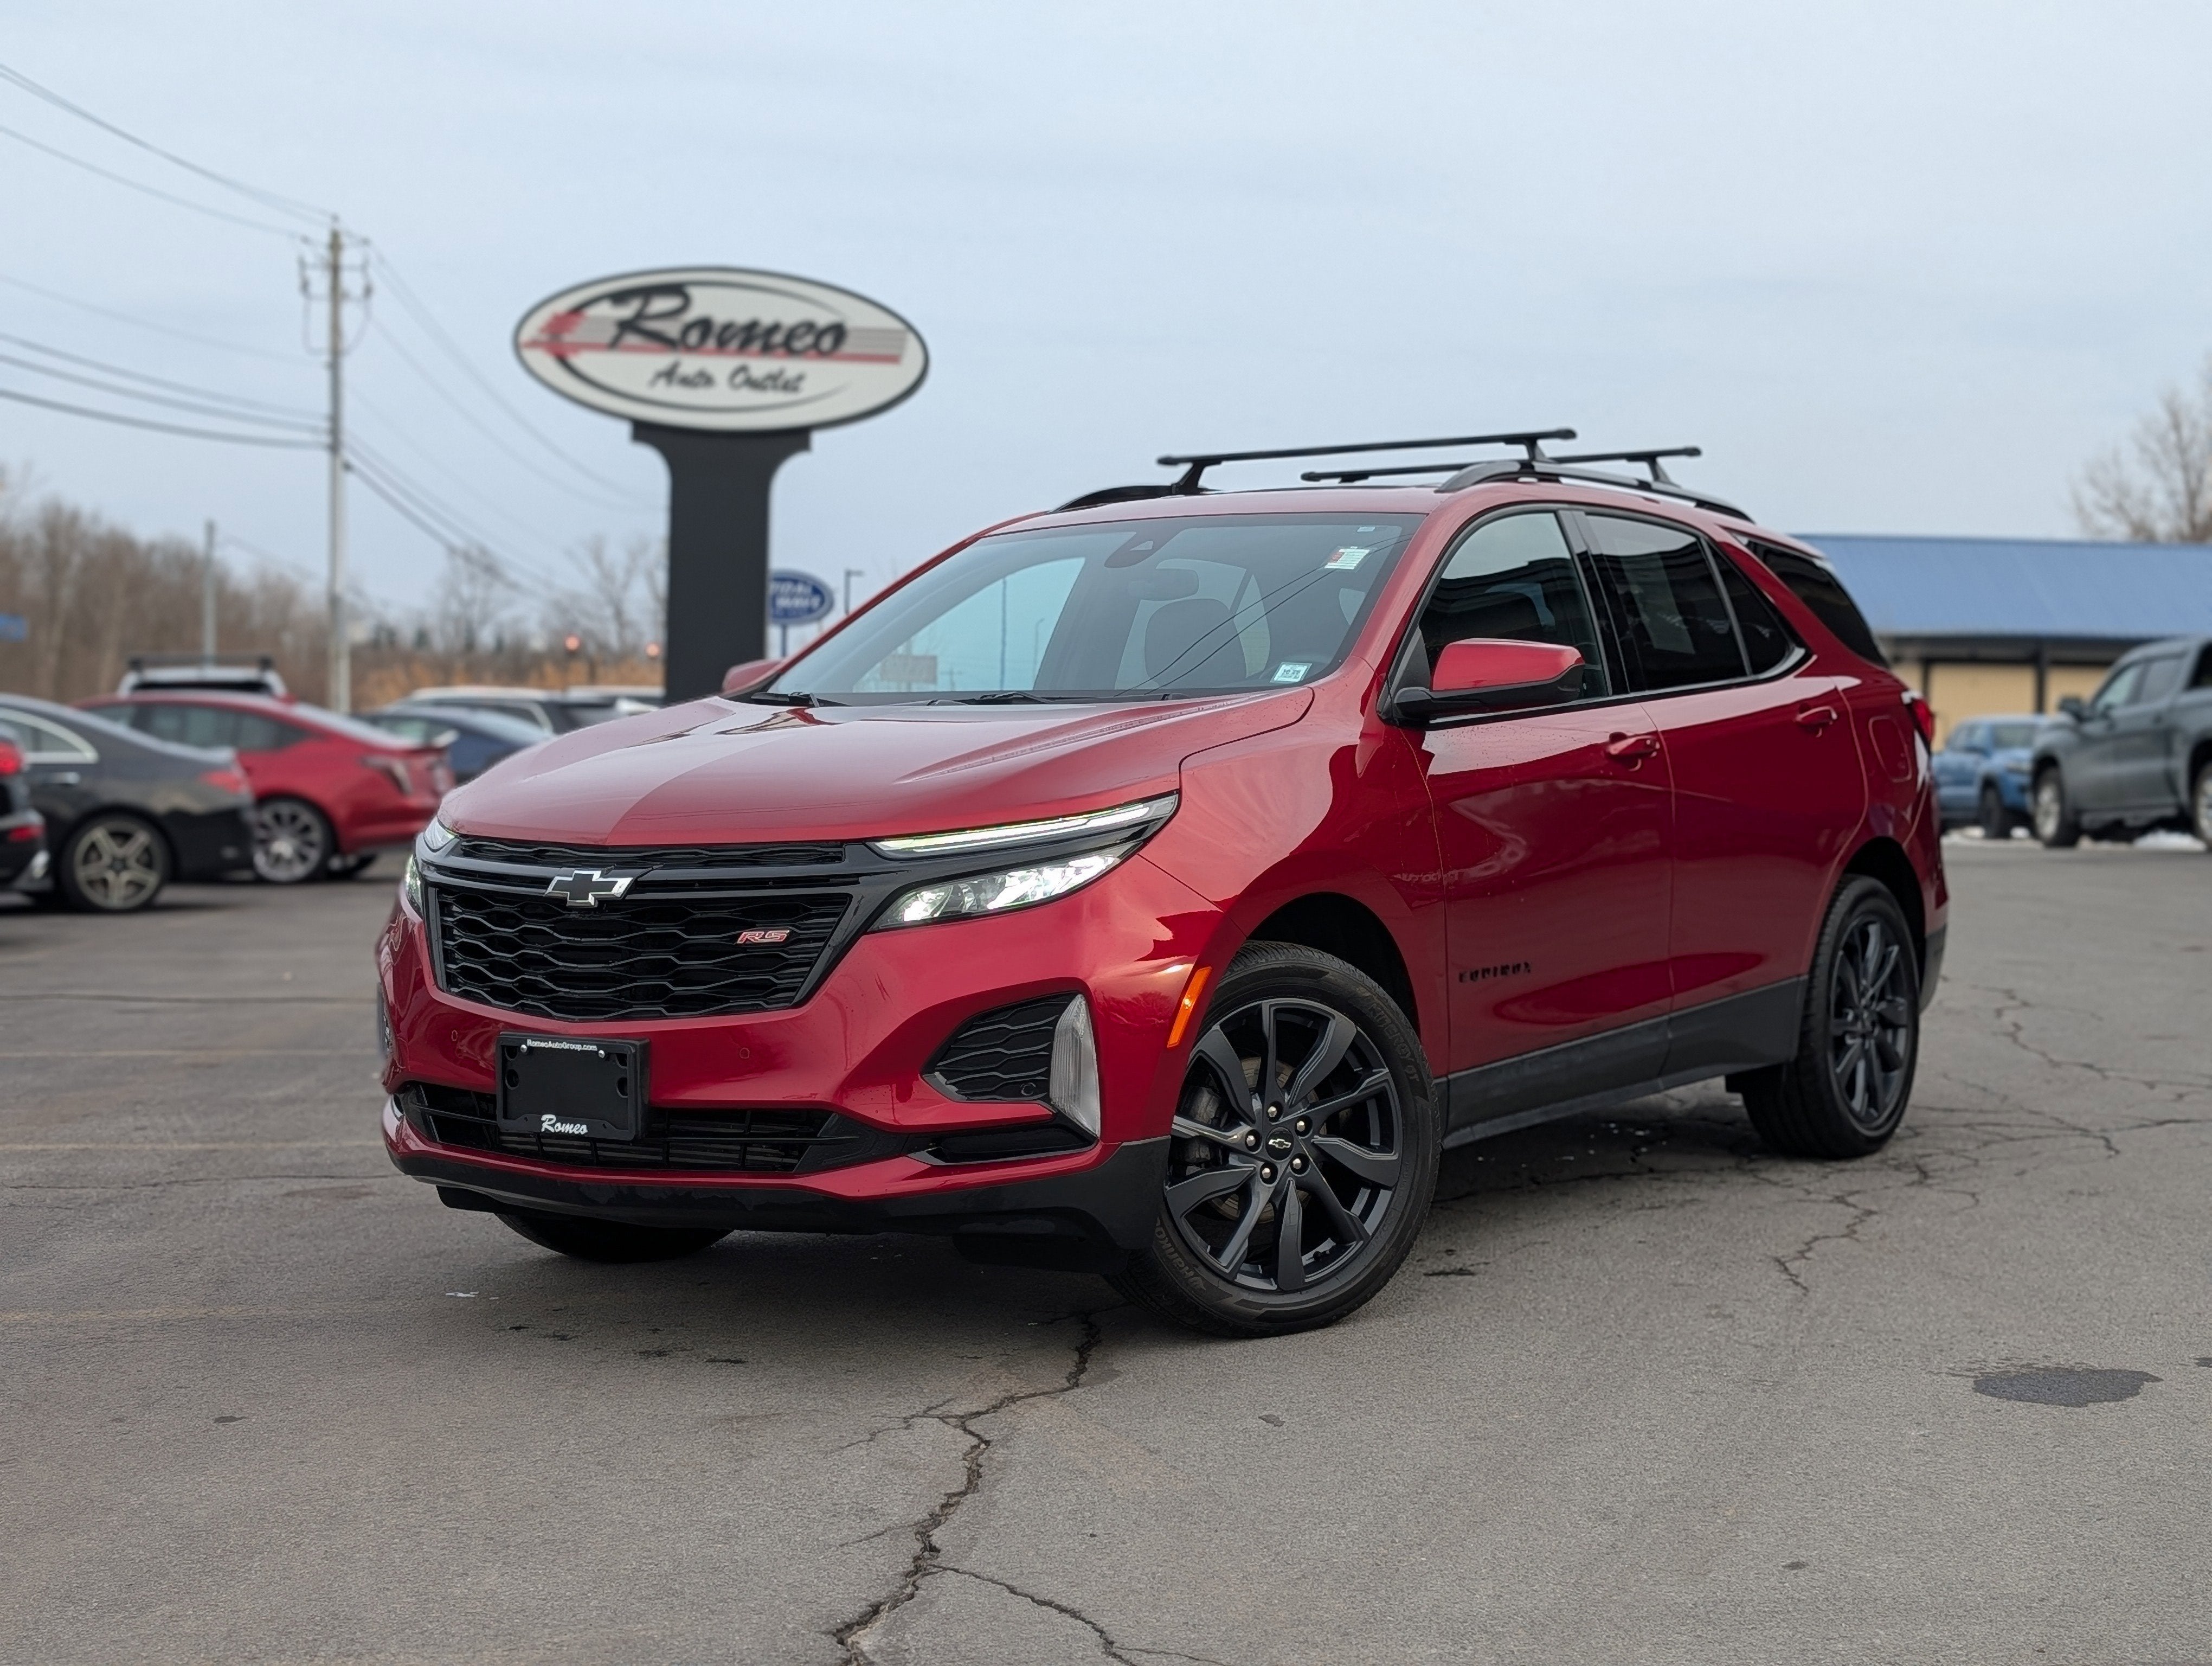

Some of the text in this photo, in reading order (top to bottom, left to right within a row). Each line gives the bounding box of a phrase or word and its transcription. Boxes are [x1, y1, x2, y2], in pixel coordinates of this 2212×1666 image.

[607, 283, 847, 356] Romeo
[651, 360, 803, 394] Auto Outlet
[737, 930, 790, 944] RS
[526, 1039, 597, 1051] RomeoAutoGroup.com
[541, 1114, 588, 1135] Romeo
[1155, 1216, 1195, 1279] Hanko
